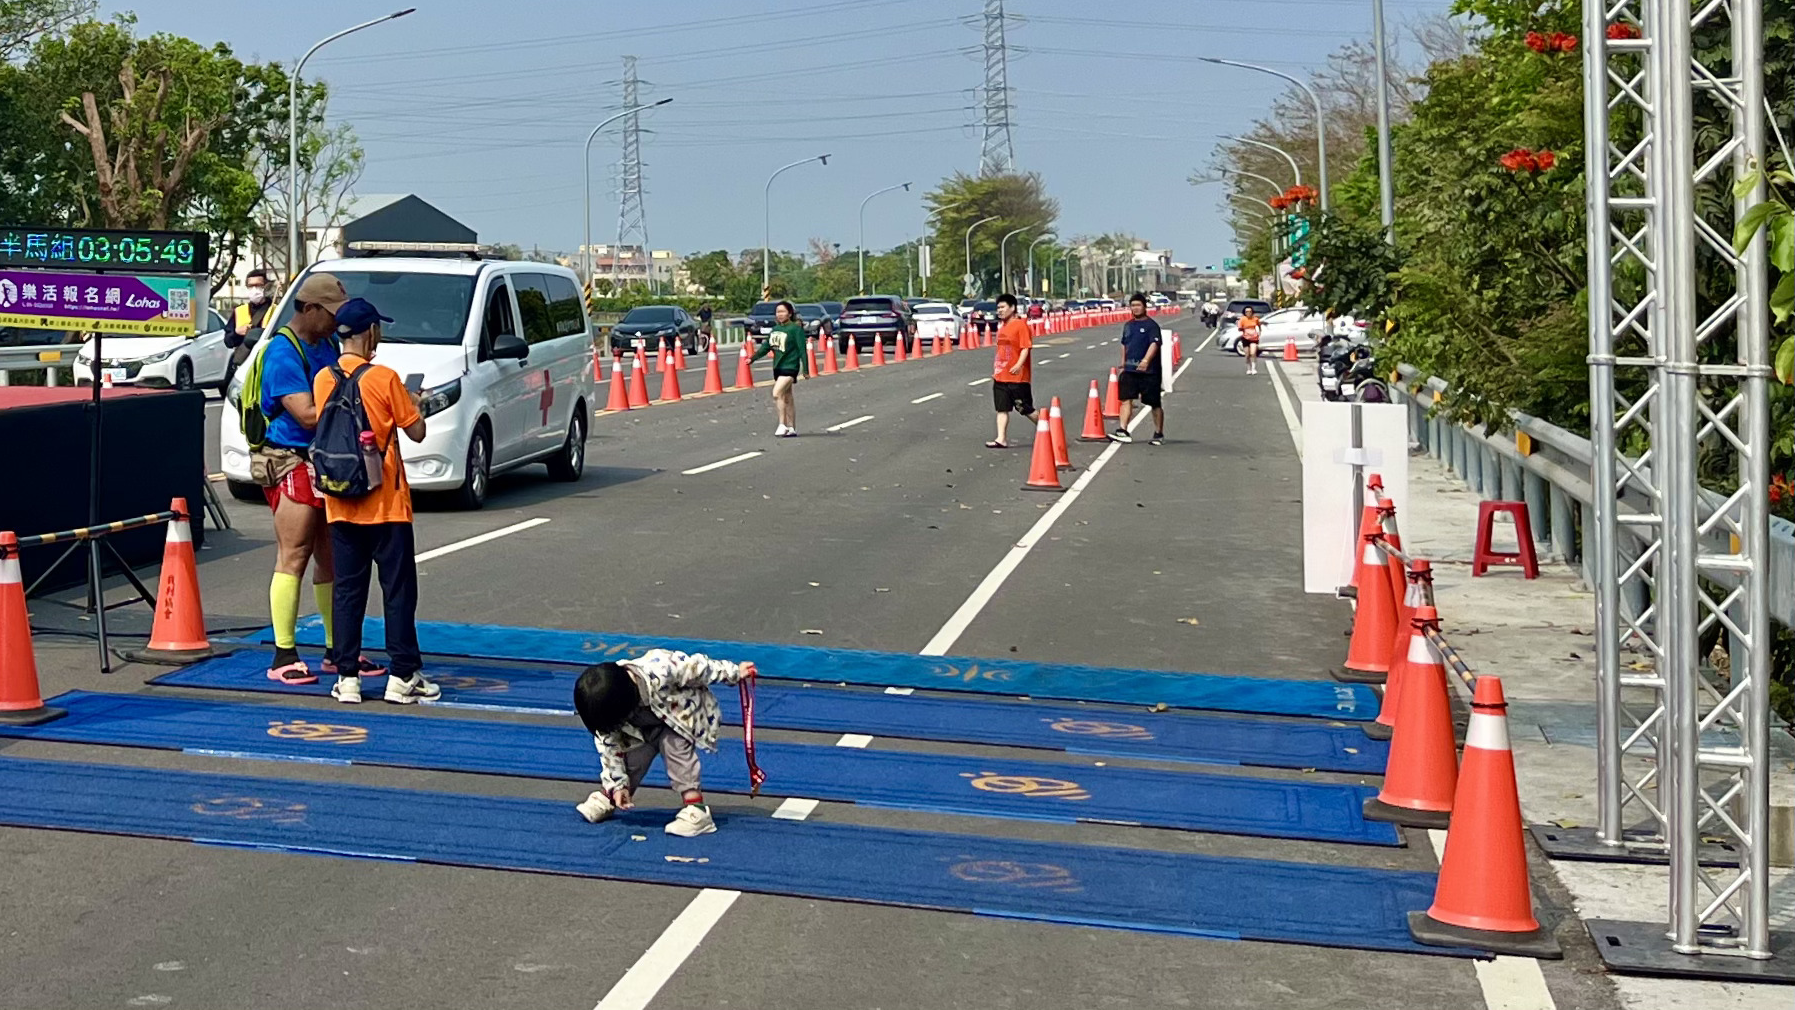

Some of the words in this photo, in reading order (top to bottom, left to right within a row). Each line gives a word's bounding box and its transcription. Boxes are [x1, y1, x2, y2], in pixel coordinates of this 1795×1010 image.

[21, 282, 122, 306] 樂活報名網
[125, 293, 161, 309] Lohas
